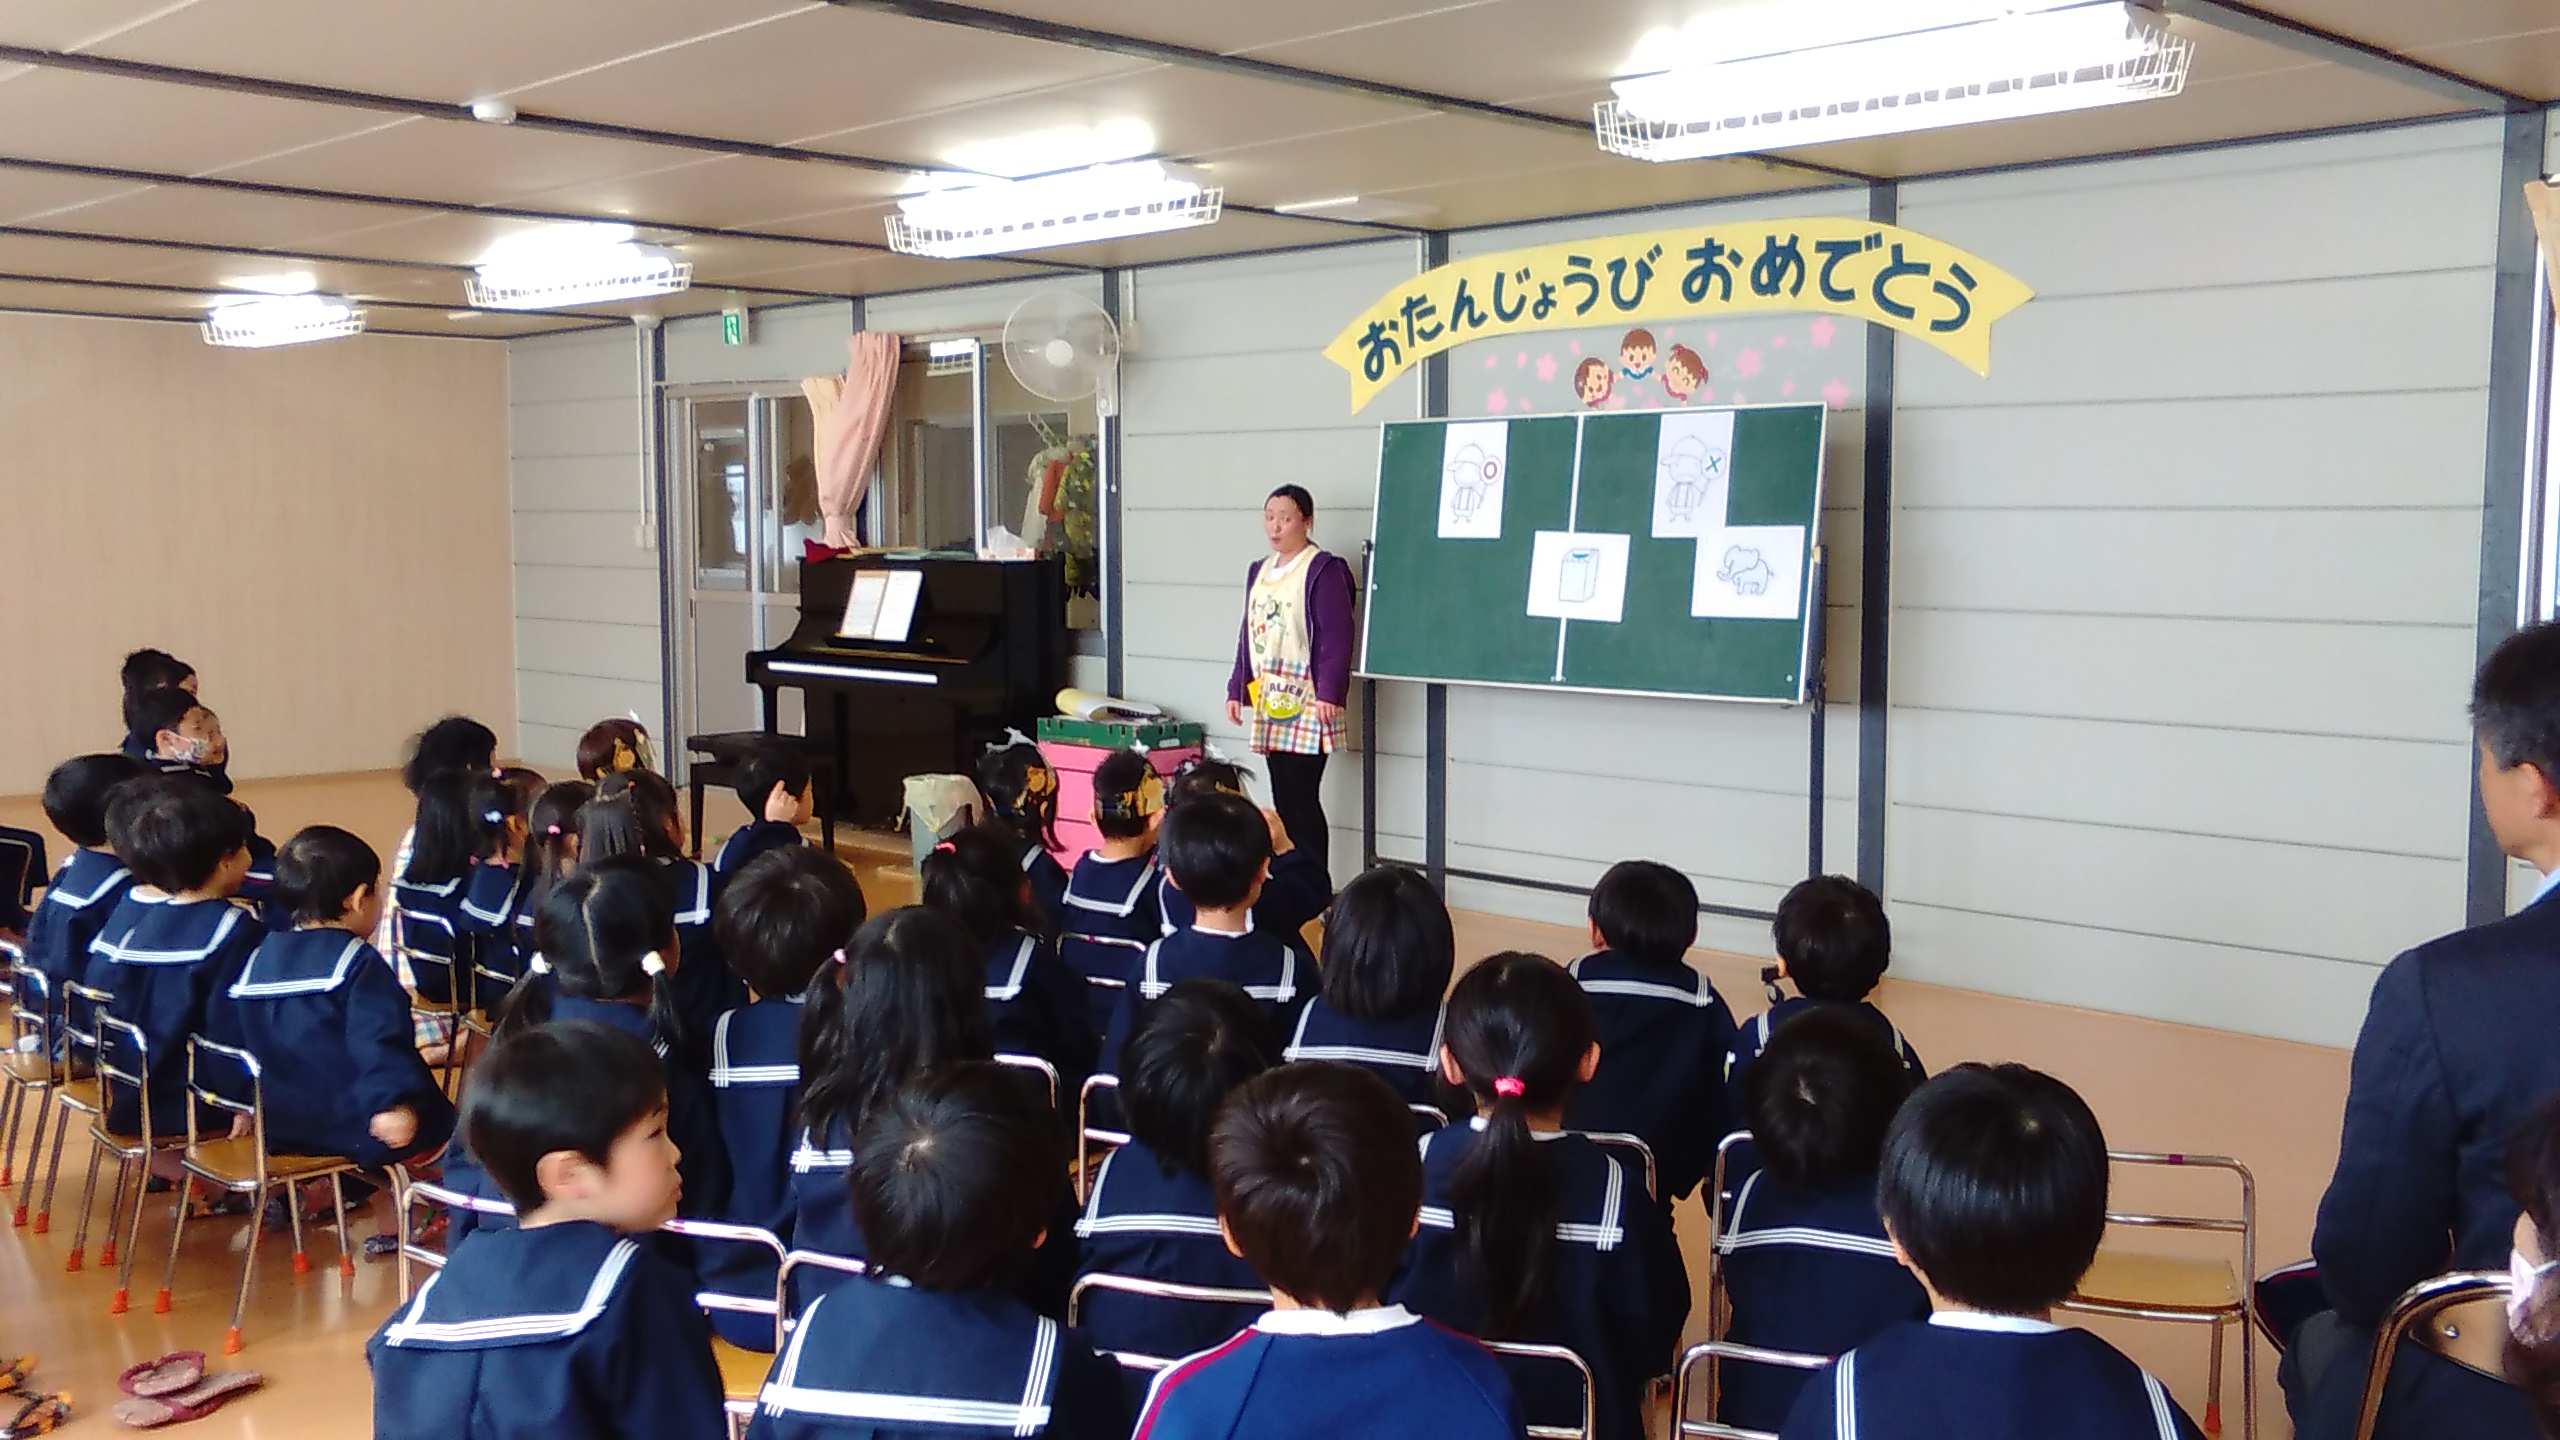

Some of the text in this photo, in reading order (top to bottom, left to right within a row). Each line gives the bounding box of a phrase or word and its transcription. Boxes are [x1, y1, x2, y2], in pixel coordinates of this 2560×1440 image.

[1357, 232, 1978, 383] おたんじょうび おめでとう
